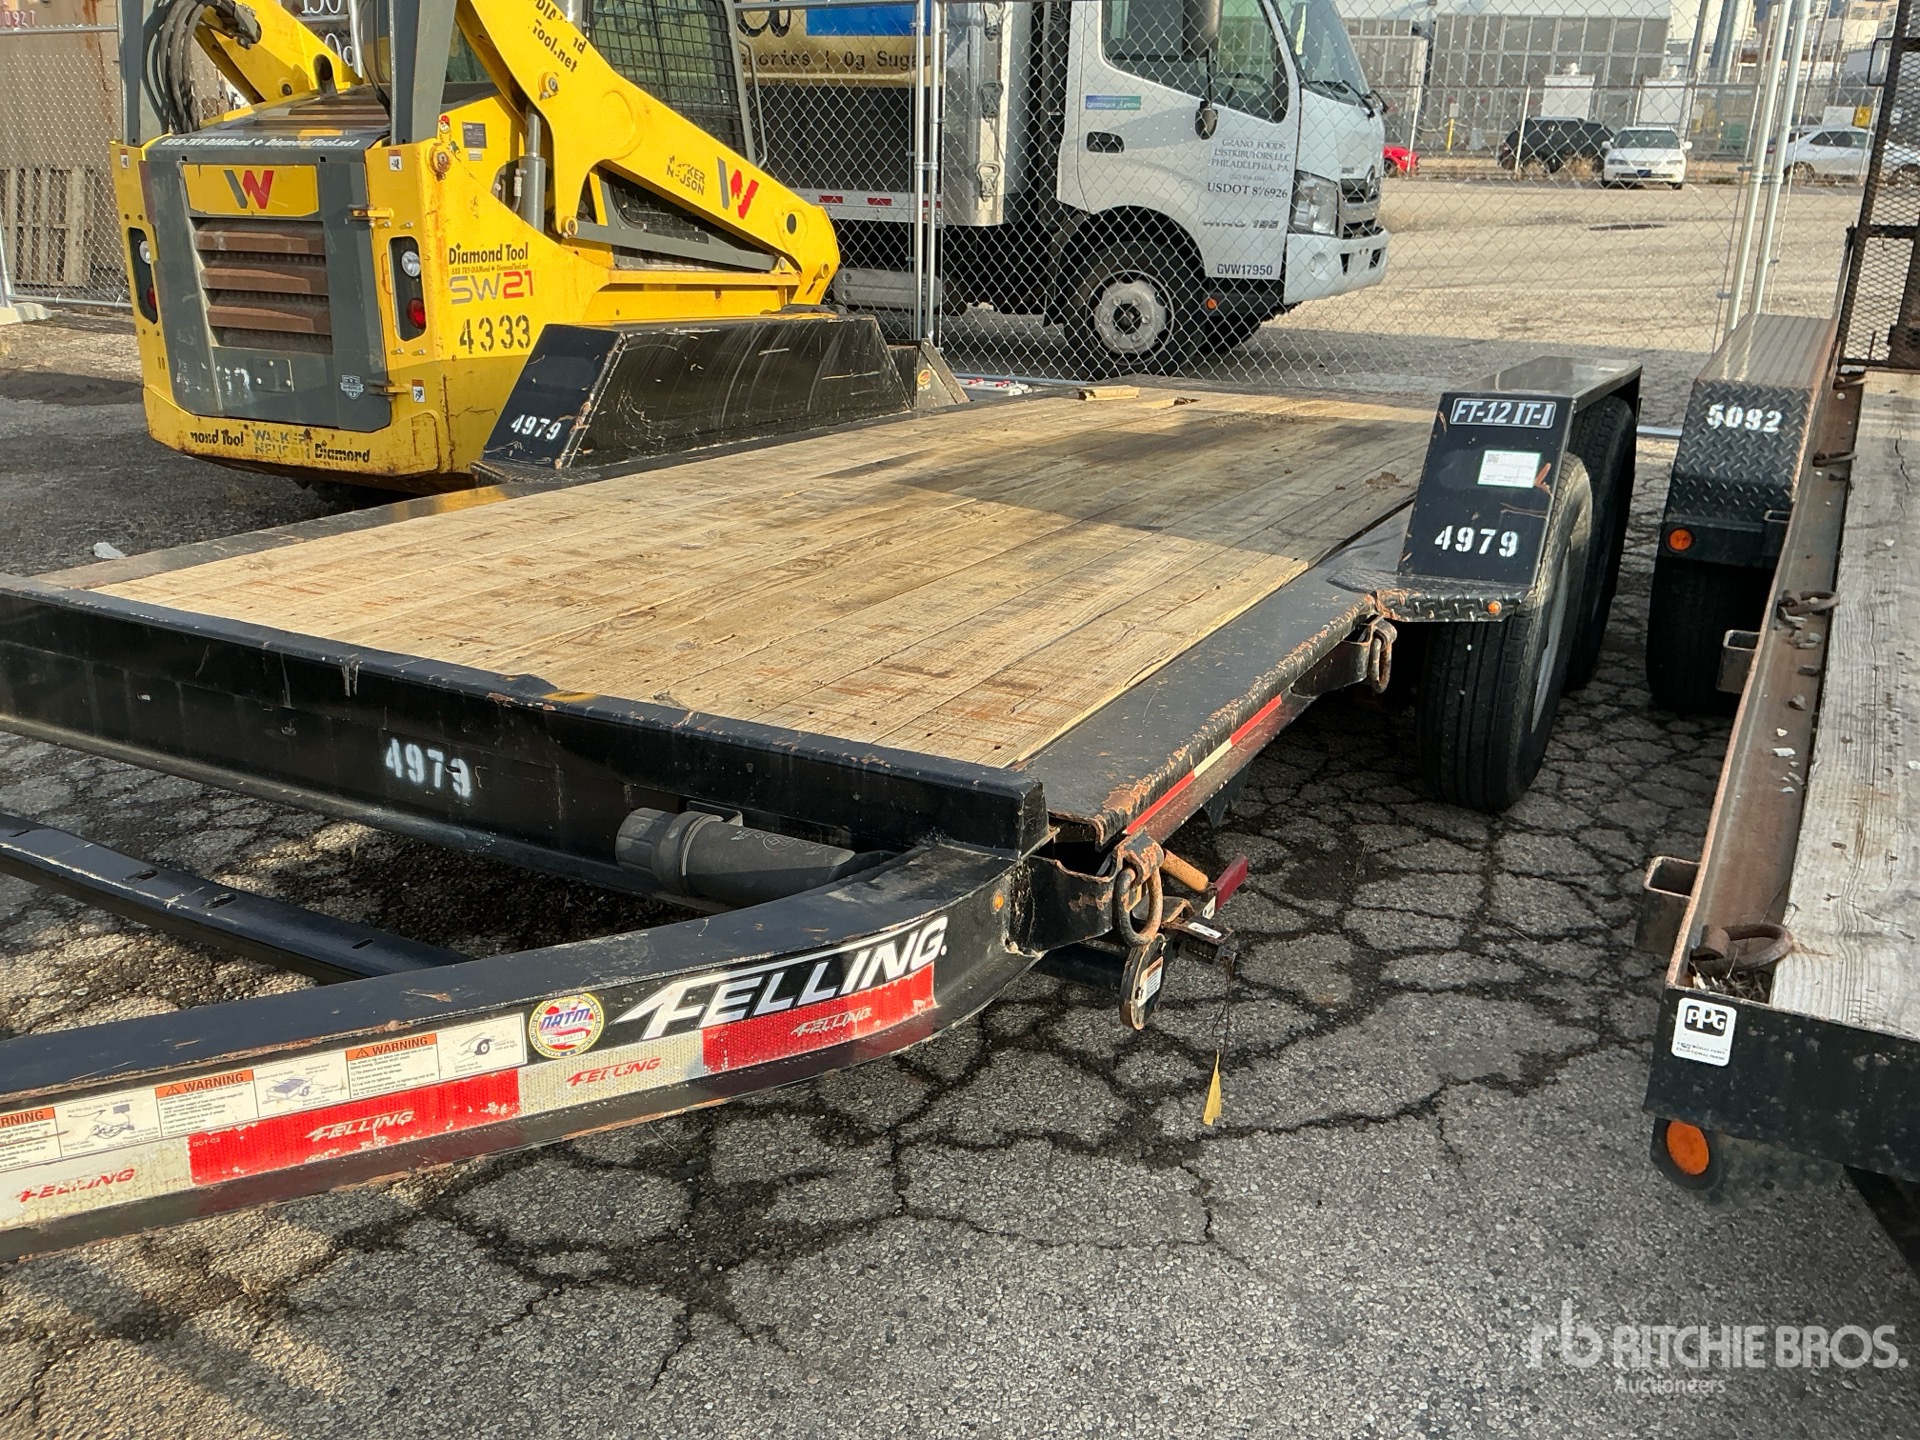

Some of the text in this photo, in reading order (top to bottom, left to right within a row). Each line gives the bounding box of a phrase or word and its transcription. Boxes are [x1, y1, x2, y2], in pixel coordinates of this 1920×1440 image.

[264, 138, 360, 148] DiamondTool.net
[1257, 141, 1286, 150] FOODS
[1207, 182, 1250, 195] USDOT
[448, 241, 529, 265] Diamond Tool
[1216, 263, 1273, 276] GVW17950
[449, 269, 534, 305] SW21
[459, 314, 531, 354] 4333
[1452, 400, 1554, 426] FT-12 IT-I
[221, 429, 244, 447] Tool
[510, 414, 562, 440] 4979
[1434, 525, 1518, 557] 4979
[386, 737, 471, 798] 4979
[540, 1007, 591, 1031] NATM
[1686, 1006, 1727, 1031] PPG
[371, 1036, 428, 1055] WARNING
[183, 1072, 244, 1092] WARNING
[304, 1108, 416, 1143] FELLING
